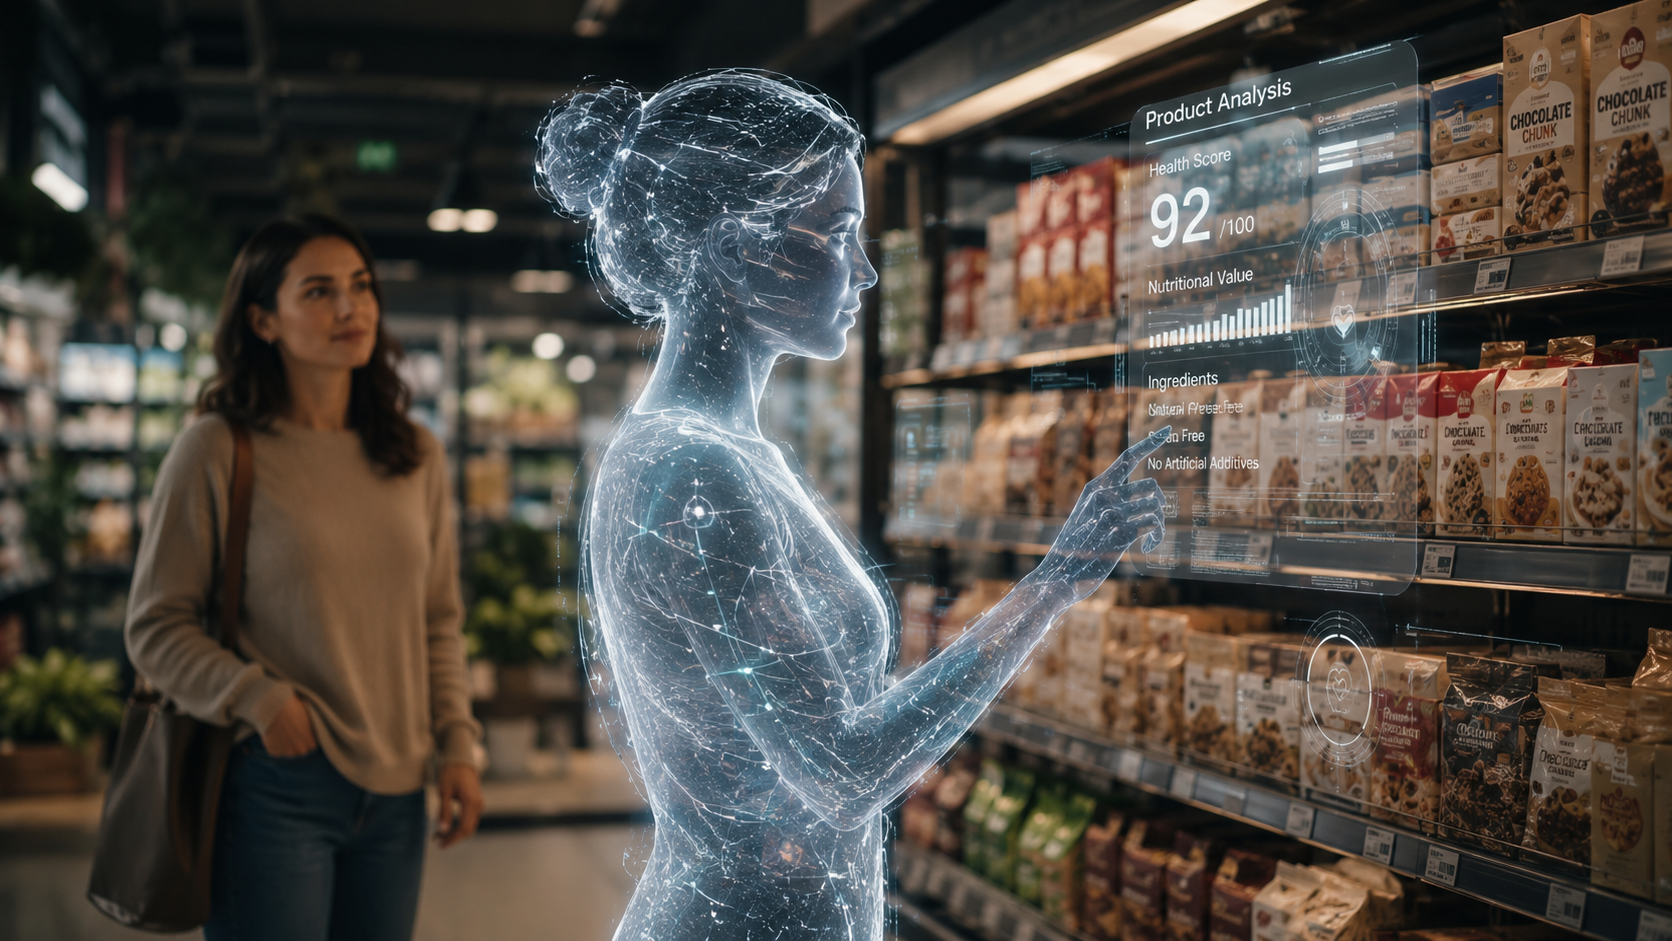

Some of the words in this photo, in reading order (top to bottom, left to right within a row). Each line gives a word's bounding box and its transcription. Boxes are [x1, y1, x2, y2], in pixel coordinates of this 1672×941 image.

[1146, 97, 1213, 130] Product
[1217, 78, 1292, 112] Analysis
[1596, 80, 1668, 113] CHOCOLATE
[1510, 101, 1572, 131] CHOCOLATE
[1611, 103, 1652, 127] CHUNK
[1522, 123, 1558, 144] CHUNK
[1149, 156, 1190, 178] Health
[1193, 150, 1232, 168] Score
[1150, 187, 1211, 248] 92
[1219, 215, 1255, 239] /100
[1148, 271, 1214, 295] Nutritional
[1216, 268, 1254, 285] Value
[1148, 372, 1219, 393] Ingredients
[1181, 428, 1206, 442] Free
[1147, 457, 1163, 470] No
[1164, 456, 1207, 470] Artificial
[1209, 456, 1260, 470] Additives
